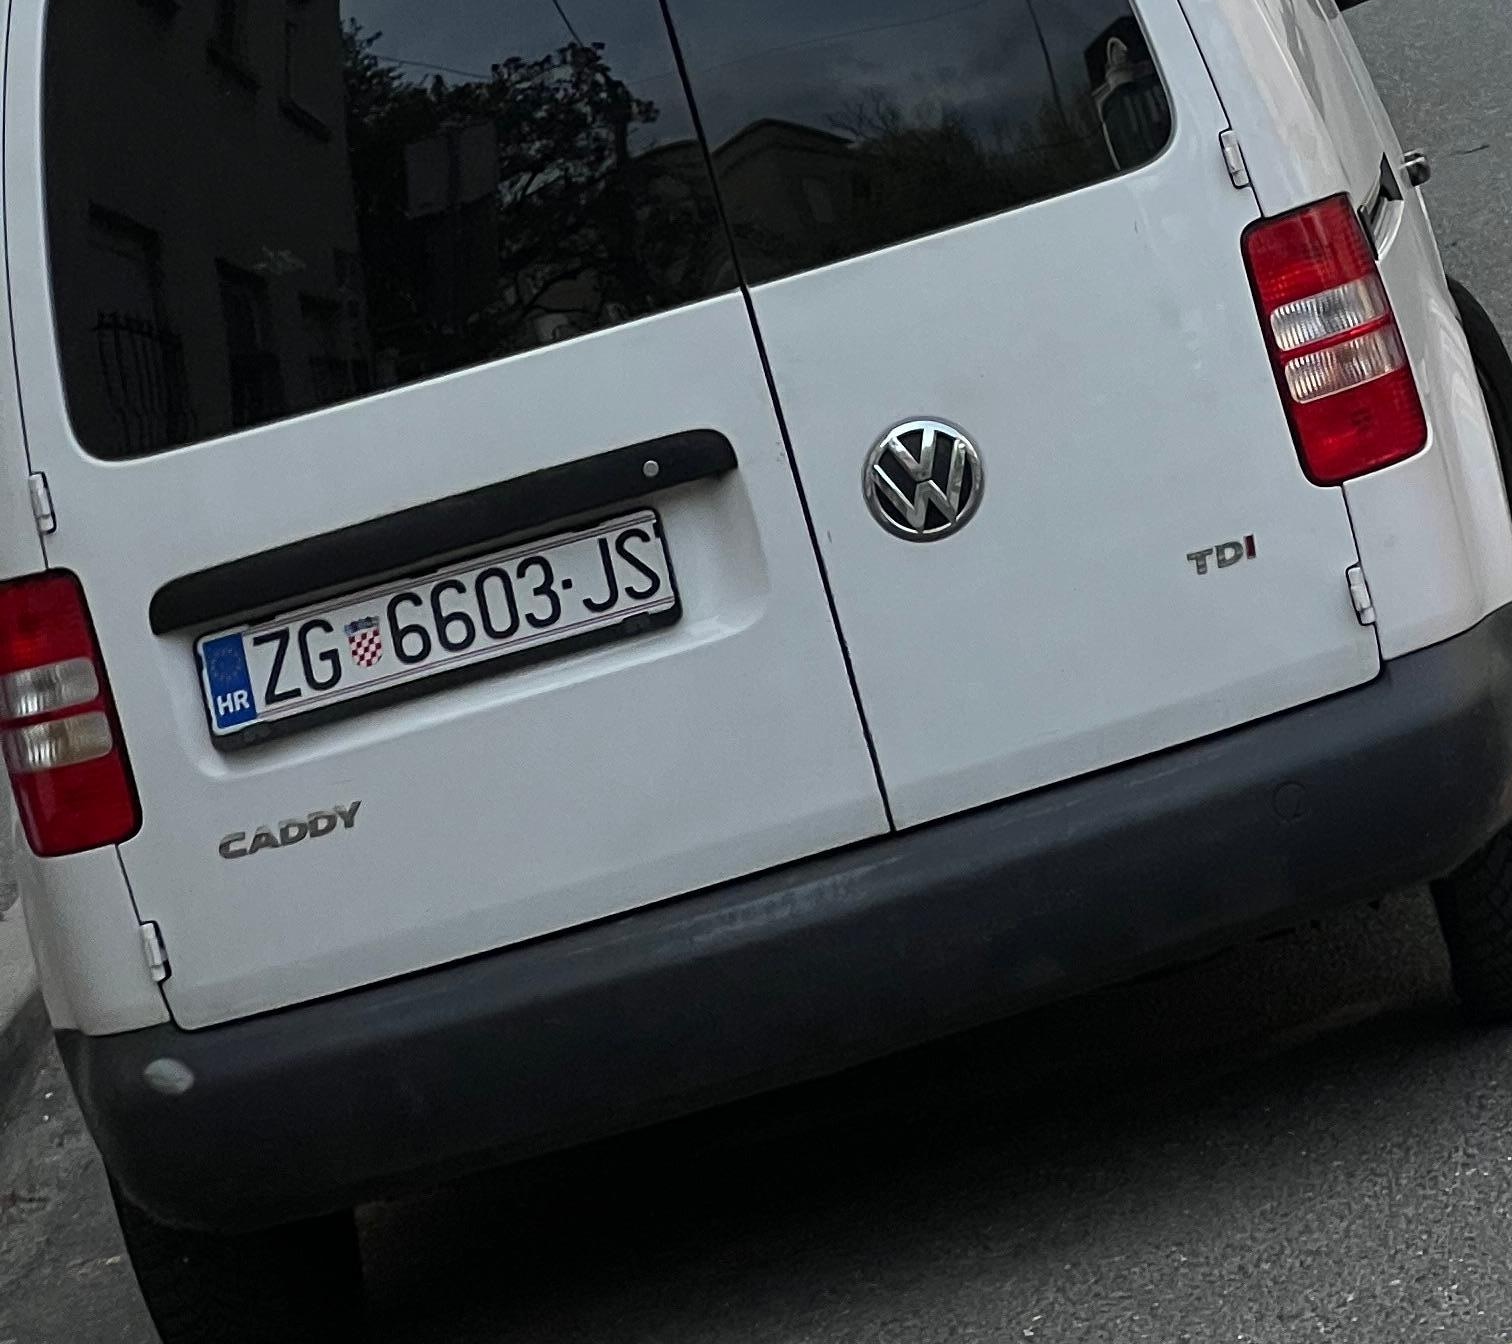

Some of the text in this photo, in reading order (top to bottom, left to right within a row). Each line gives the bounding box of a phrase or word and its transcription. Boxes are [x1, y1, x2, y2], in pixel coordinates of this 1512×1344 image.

[1186, 534, 1256, 575] TDI
[216, 689, 250, 716] HR
[252, 617, 343, 707] ZG
[218, 800, 362, 859] CADDY
